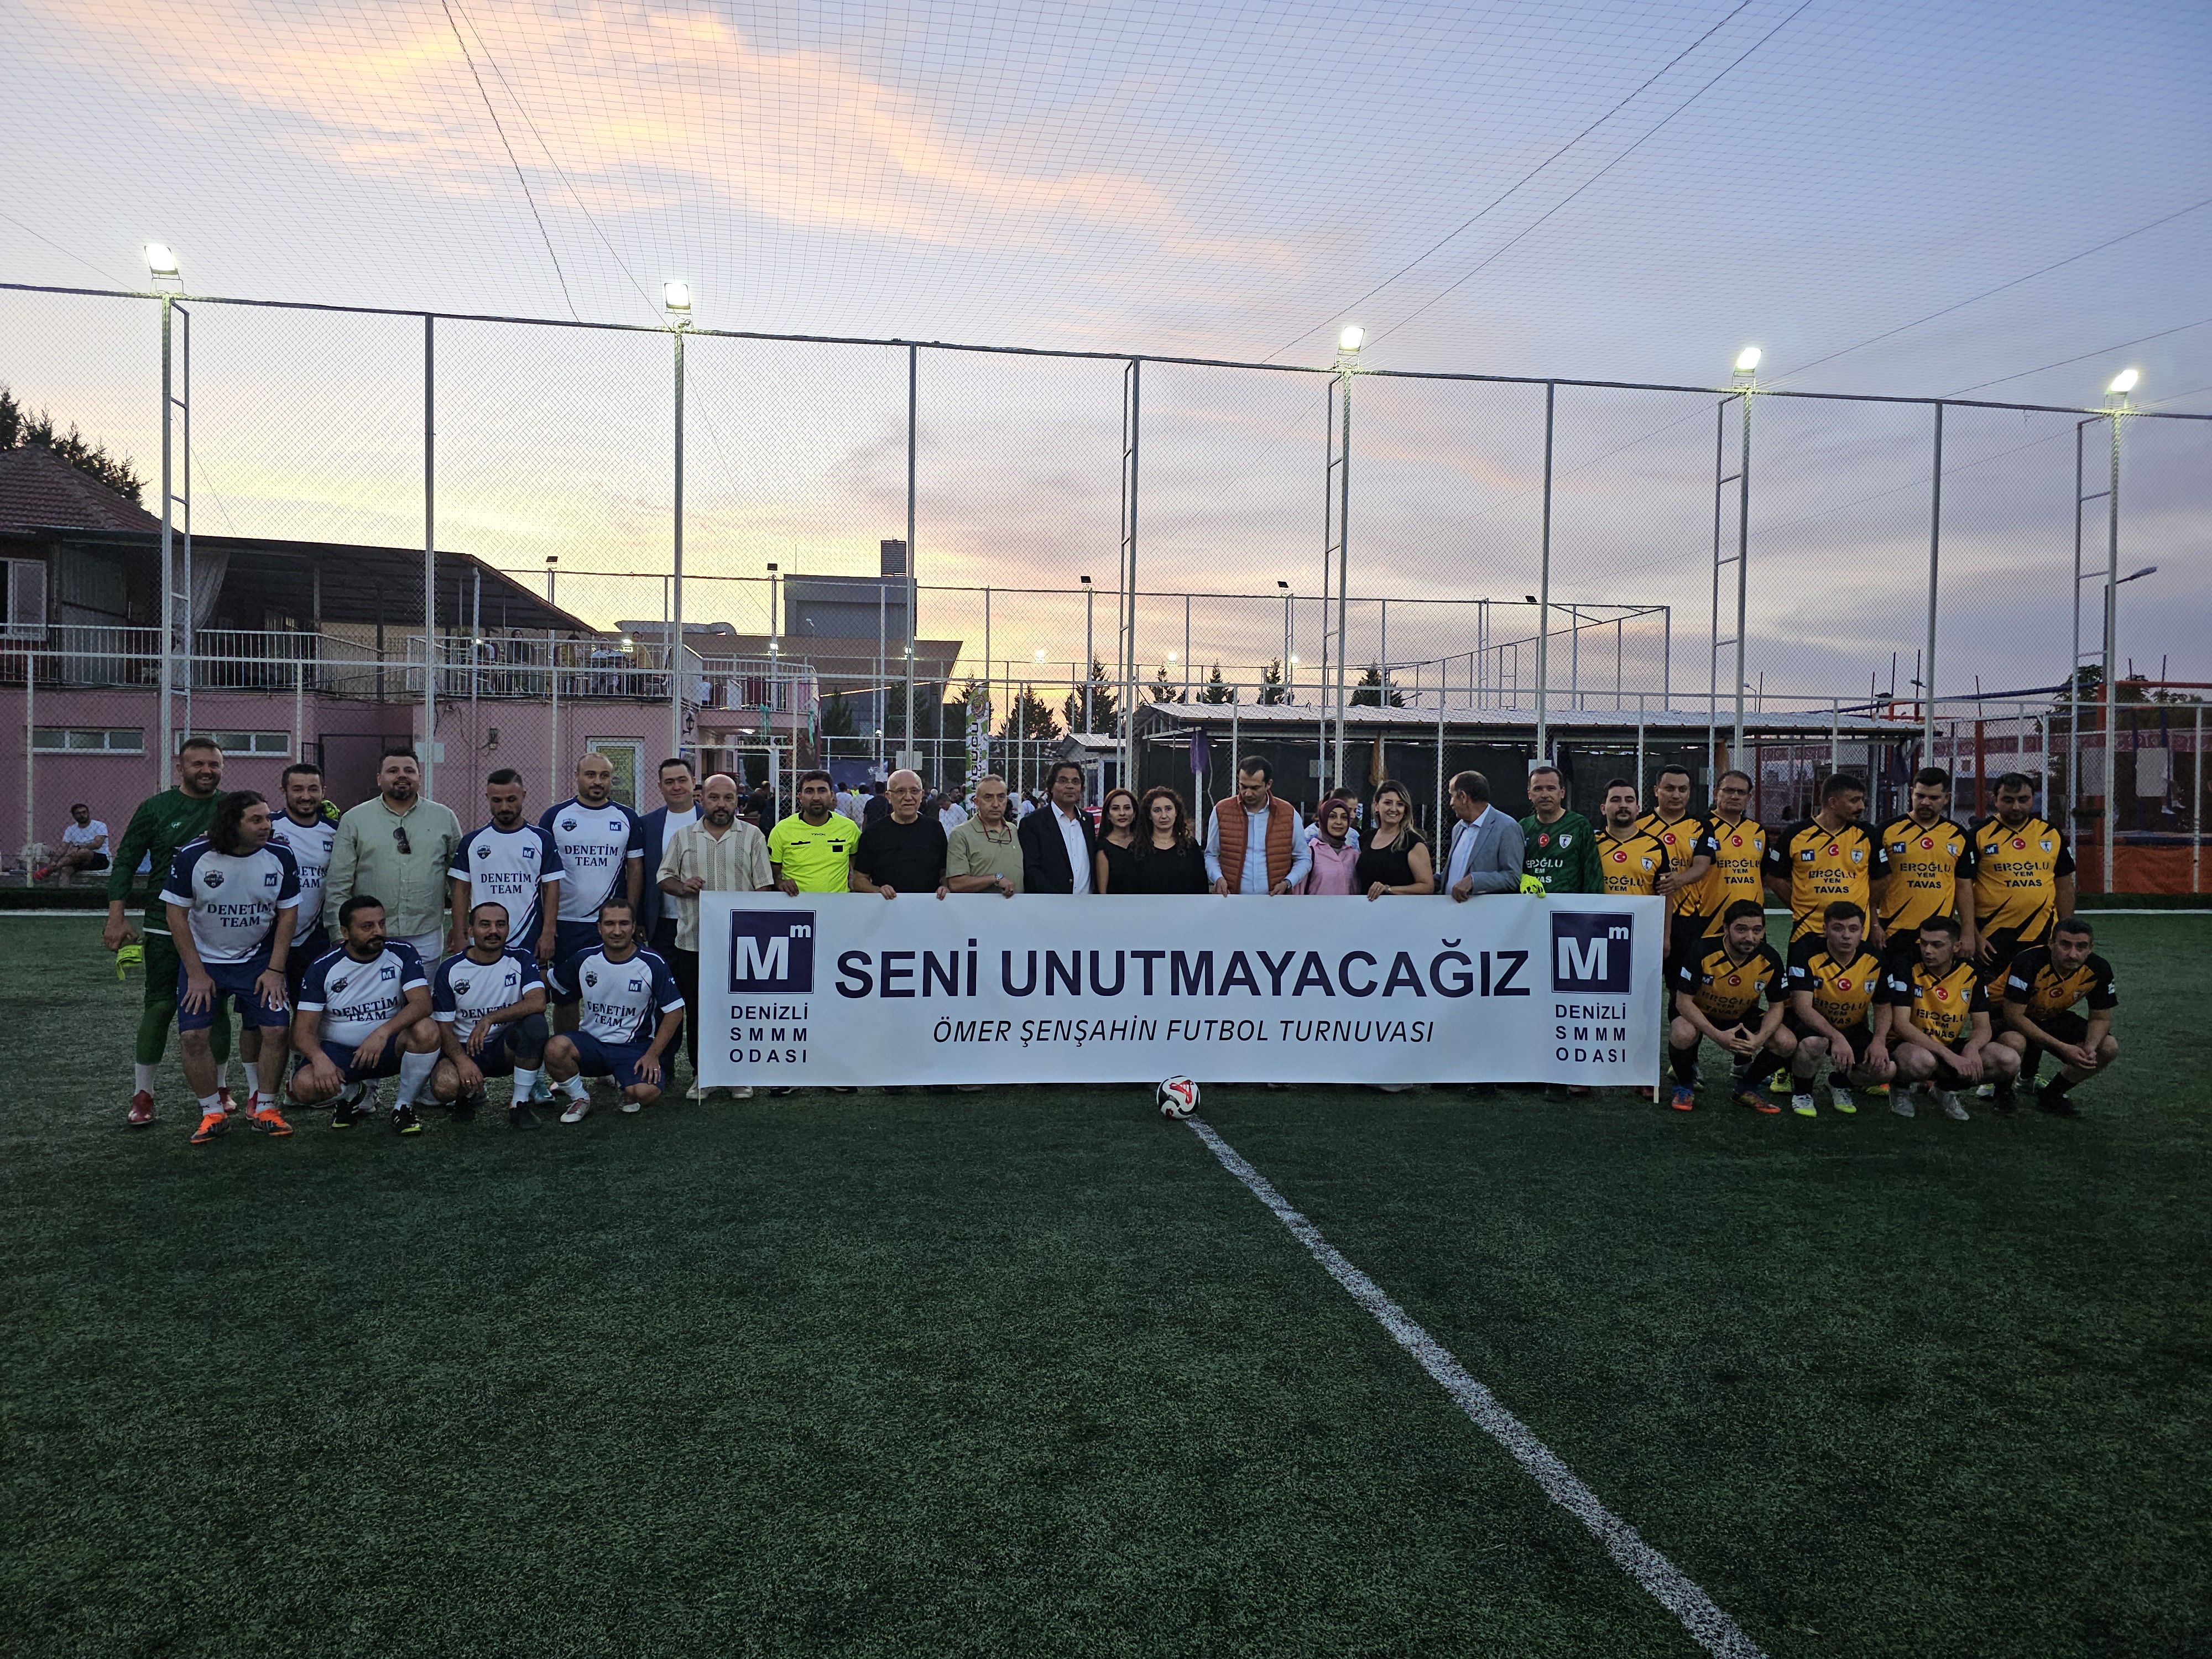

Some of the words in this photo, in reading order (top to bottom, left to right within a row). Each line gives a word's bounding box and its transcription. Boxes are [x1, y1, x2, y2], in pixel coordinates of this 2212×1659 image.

[565, 843, 618, 855] DENETİM
[575, 857, 607, 866] TEAM
[1900, 862, 1951, 873] EROĞLU
[1993, 861, 2049, 872] EROĞLU
[481, 871, 531, 883] DENETİM
[1724, 877, 1754, 885] TAVAS
[491, 885, 521, 894] TEAM
[1907, 880, 1942, 889] TAVAS
[2004, 879, 2042, 888] TAVAS
[207, 901, 271, 915] DENETİM
[220, 916, 260, 927] TEAM
[835, 938, 977, 998] SENİ
[1001, 938, 1530, 998] UNUTMAYACAĞIZ
[332, 996, 398, 1018] DENETİM
[587, 1001, 636, 1016] DENETİM
[731, 1003, 807, 1019] DENİZLİ
[1556, 1002, 1626, 1020] DENİZLİ
[1704, 1004, 1739, 1015] TAVAS
[347, 1010, 386, 1021] TEAM
[595, 1014, 622, 1027] TEAM
[933, 1016, 1011, 1042] ÖMER
[1020, 1015, 1157, 1047] ŞENŞAHİN
[1166, 1020, 1268, 1041] FUTBOL
[1280, 1020, 1433, 1042] TURNUVASI
[729, 1048, 807, 1062] ODASI
[1556, 1047, 1626, 1062] ODASI
